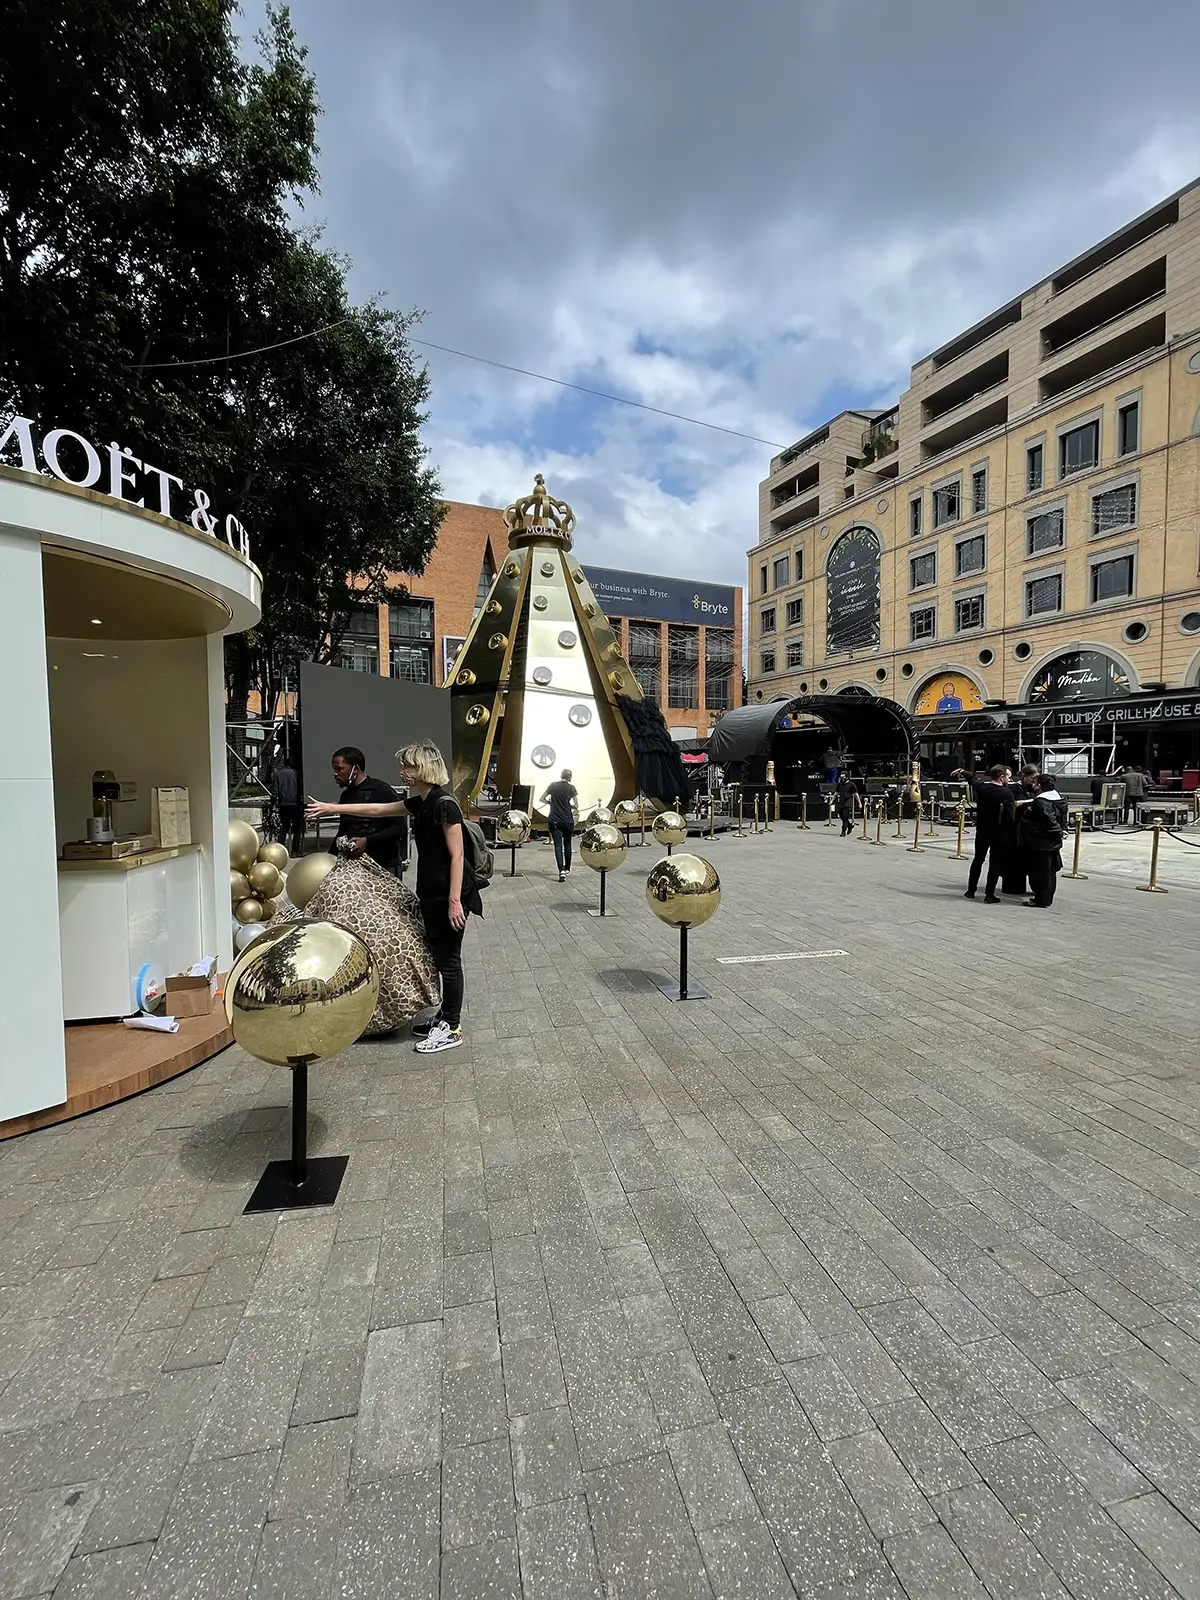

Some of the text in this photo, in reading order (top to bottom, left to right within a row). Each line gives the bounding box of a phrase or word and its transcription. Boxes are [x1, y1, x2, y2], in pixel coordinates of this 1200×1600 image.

[191, 488, 219, 539] &
[600, 582, 631, 593] business
[632, 587, 648, 596] with
[649, 588, 671, 599] Bryte.
[701, 601, 729, 615] Bryte
[1057, 672, 1102, 689] Madiba
[1057, 710, 1102, 725] TRUMPS
